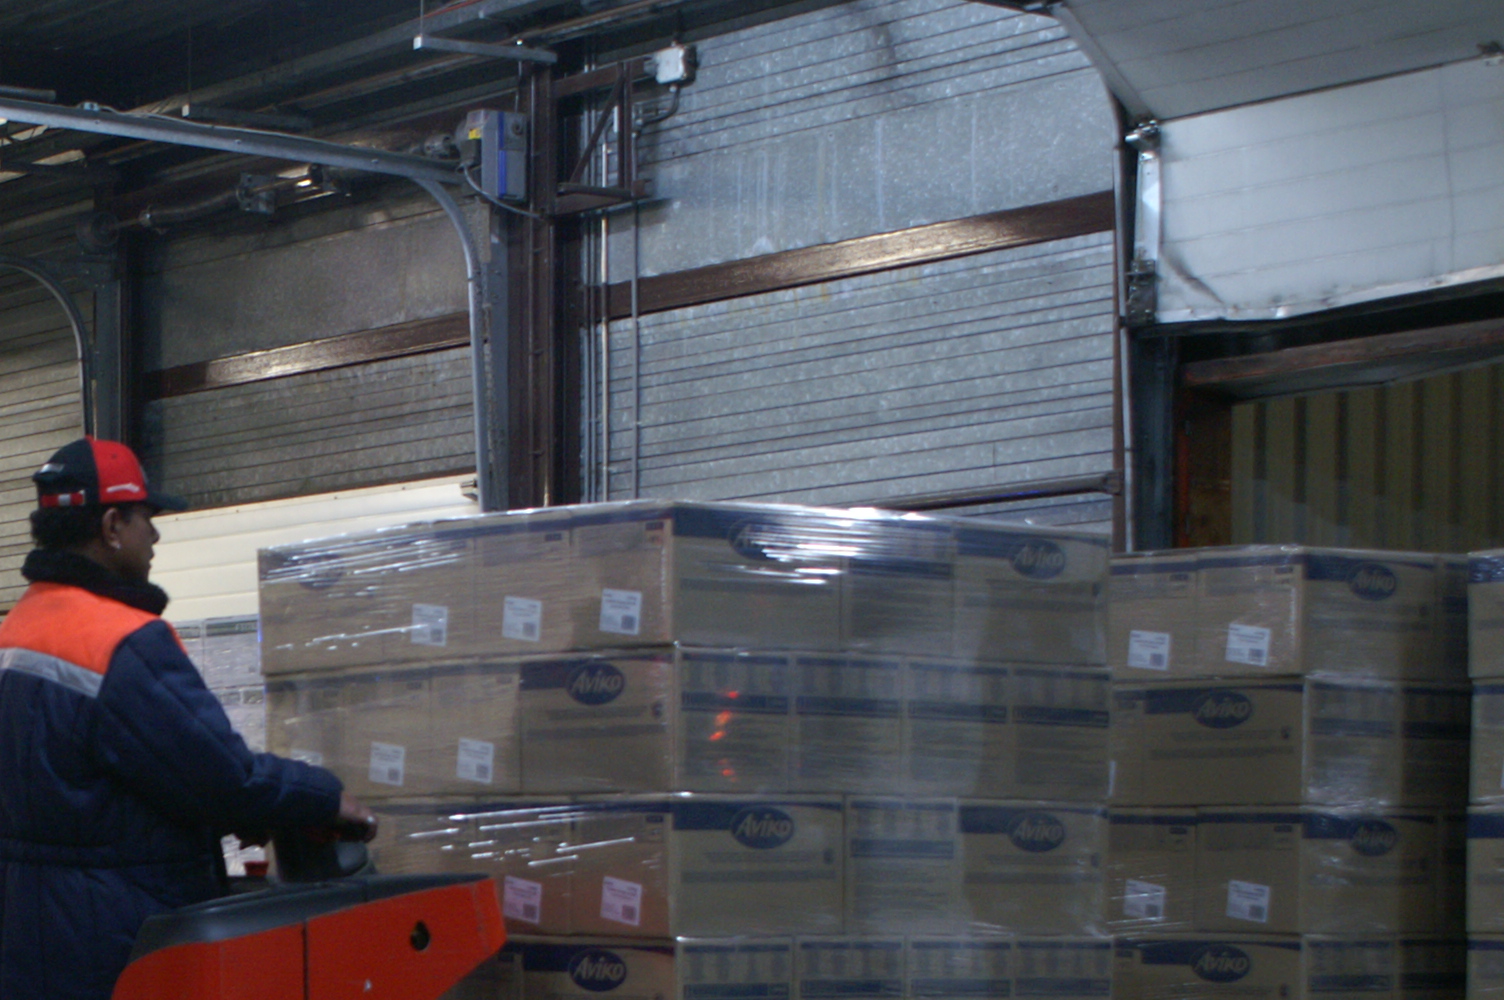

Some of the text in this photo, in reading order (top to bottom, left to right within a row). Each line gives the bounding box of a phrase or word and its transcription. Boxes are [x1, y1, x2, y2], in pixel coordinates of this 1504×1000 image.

[571, 671, 623, 695] Aviko
[733, 810, 793, 842] Aviko
[1012, 818, 1065, 845] Aviko
[571, 954, 624, 985] Aviko
